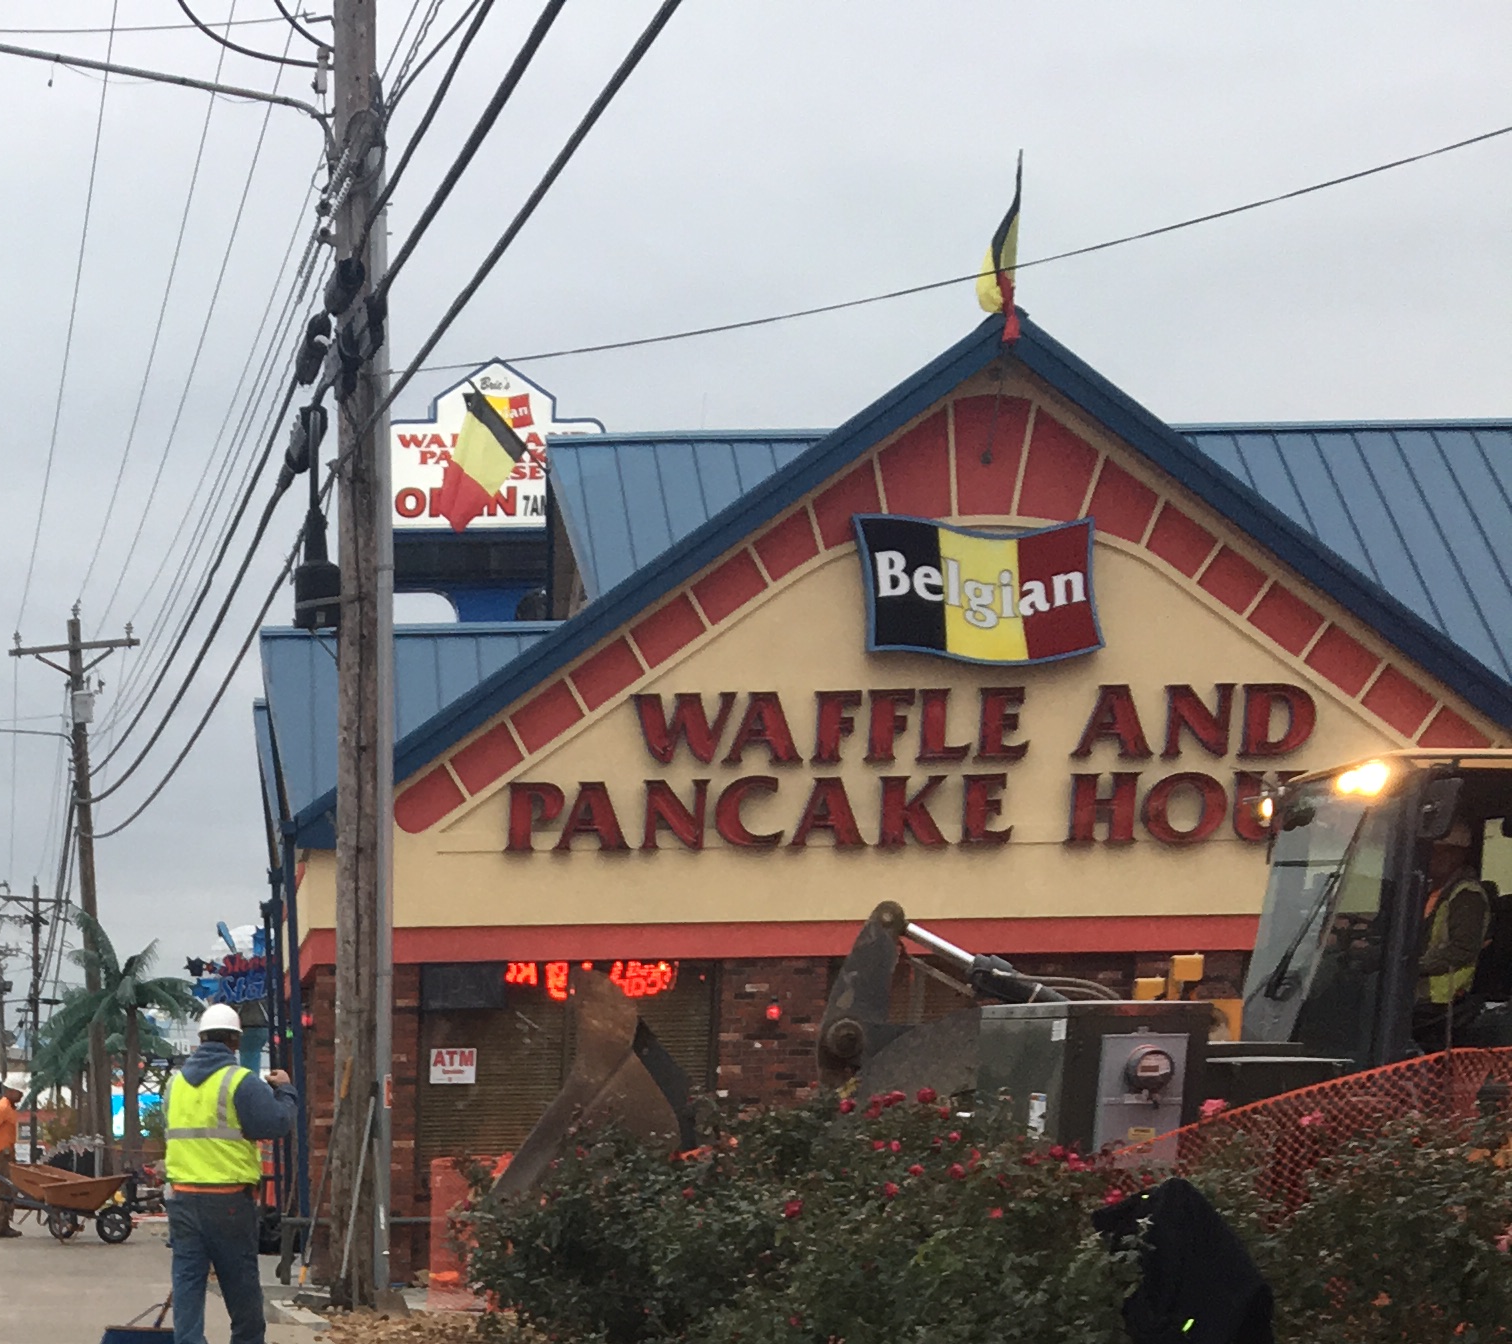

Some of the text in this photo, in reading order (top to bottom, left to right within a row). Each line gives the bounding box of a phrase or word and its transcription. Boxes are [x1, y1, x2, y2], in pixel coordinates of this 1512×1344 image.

[875, 550, 1087, 629] Belgian
[632, 682, 1317, 766] WAFFLE AND
[502, 772, 1015, 855] PANCAKE
[432, 1050, 474, 1067] ATM
